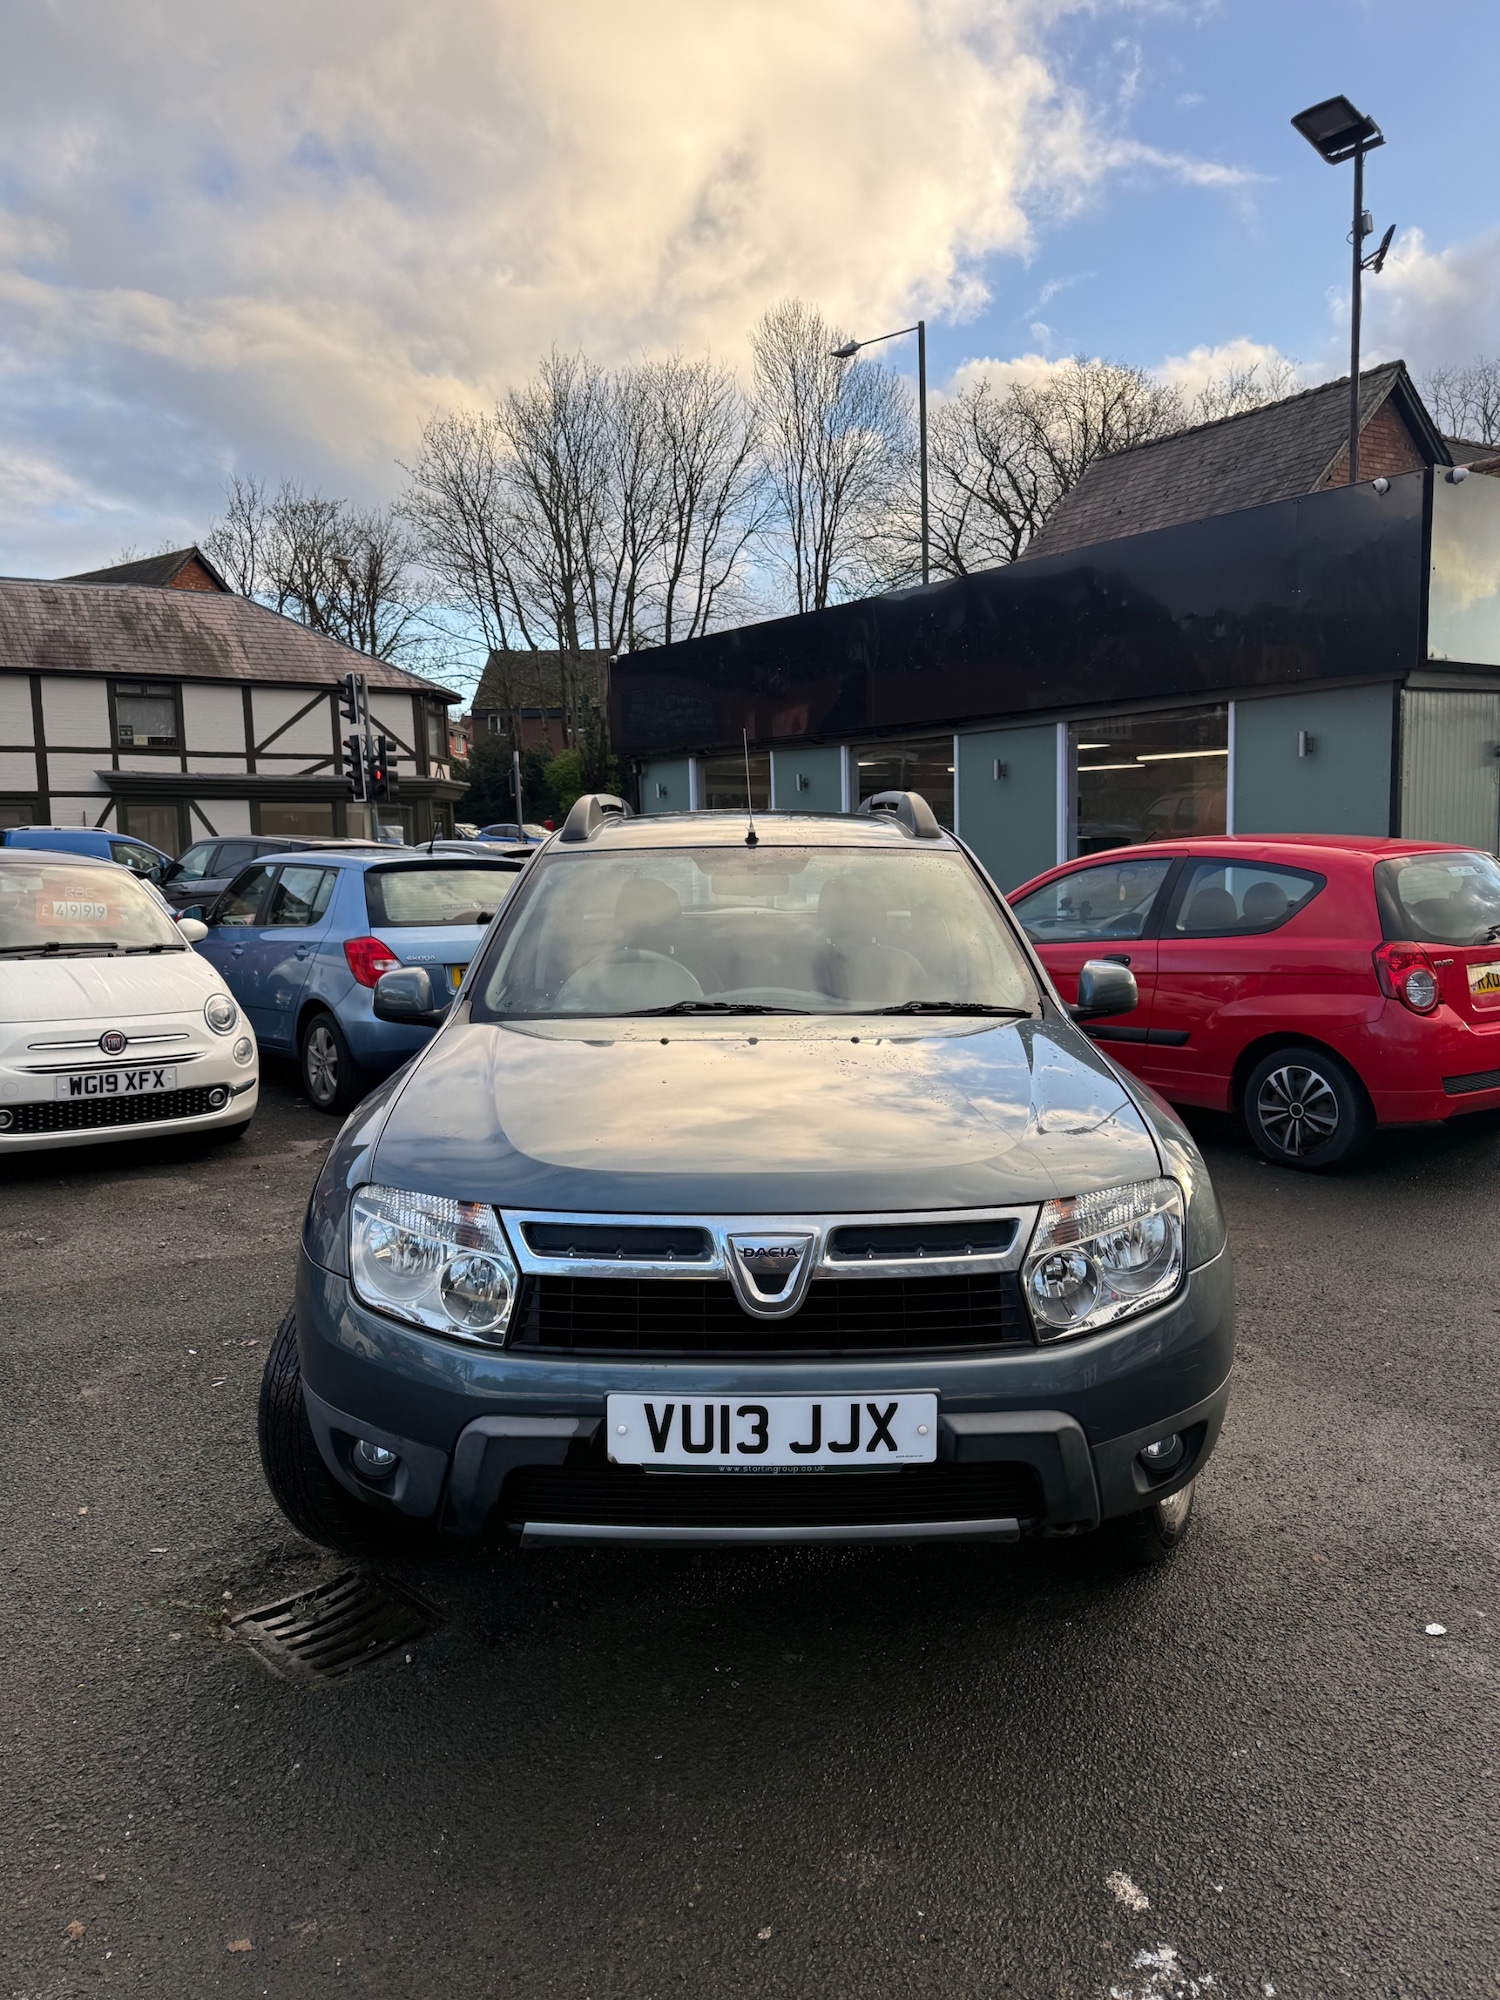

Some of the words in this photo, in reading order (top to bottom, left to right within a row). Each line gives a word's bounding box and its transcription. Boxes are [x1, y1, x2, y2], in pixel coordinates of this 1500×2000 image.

[107, 1037, 121, 1049] FIAT
[69, 1074, 118, 1096] WG19
[125, 1069, 165, 1091] XFX
[743, 1247, 799, 1258] DACIA
[643, 1403, 769, 1455] VU13
[789, 1402, 899, 1454] JJX
[718, 1465, 826, 1475] www.startingroup.co.uk
